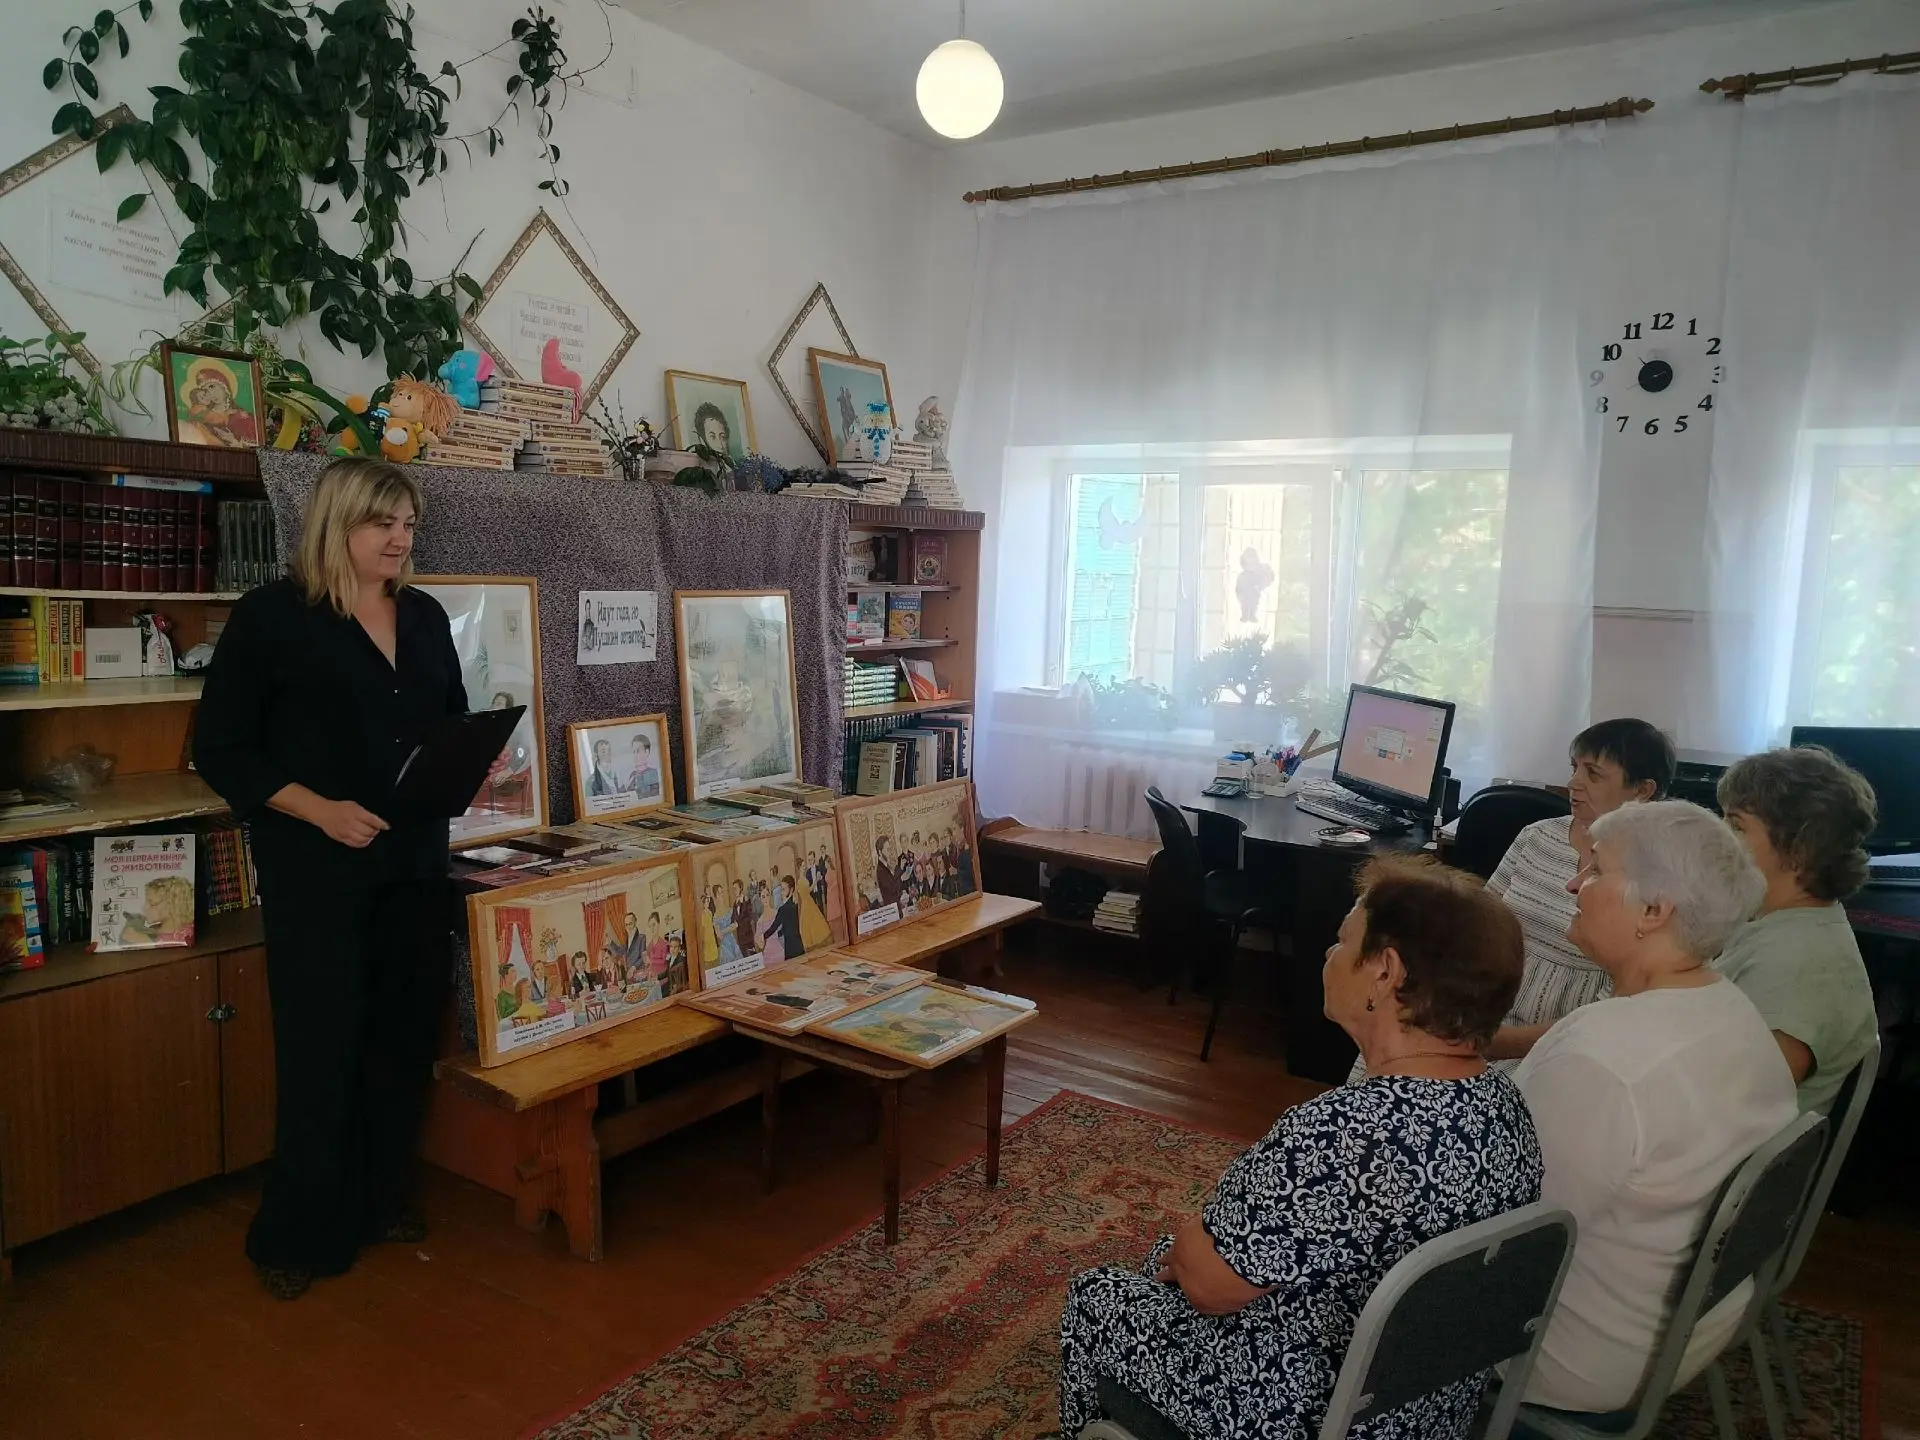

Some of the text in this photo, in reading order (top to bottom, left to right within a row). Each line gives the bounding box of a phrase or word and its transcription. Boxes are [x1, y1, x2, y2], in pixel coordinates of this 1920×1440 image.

[1651, 312, 1675, 331] 12
[1687, 318, 1698, 336] 1
[1622, 322, 1642, 340] 11
[1601, 343, 1622, 361] 10
[1706, 337, 1721, 355] 2
[1589, 369, 1604, 387] 9
[1595, 396, 1609, 413] 8
[1697, 394, 1713, 411] 4
[1616, 415, 1629, 432] 7
[1644, 418, 1660, 435] 6
[1673, 415, 1689, 433] 5
[597, 601, 614, 627] Идут
[591, 626, 619, 652] Пушкин
[104, 853, 187, 864] МОЯ ПЕРВАЯ КНИГА
[110, 862, 182, 872] О ЖИВОТНЫХ
